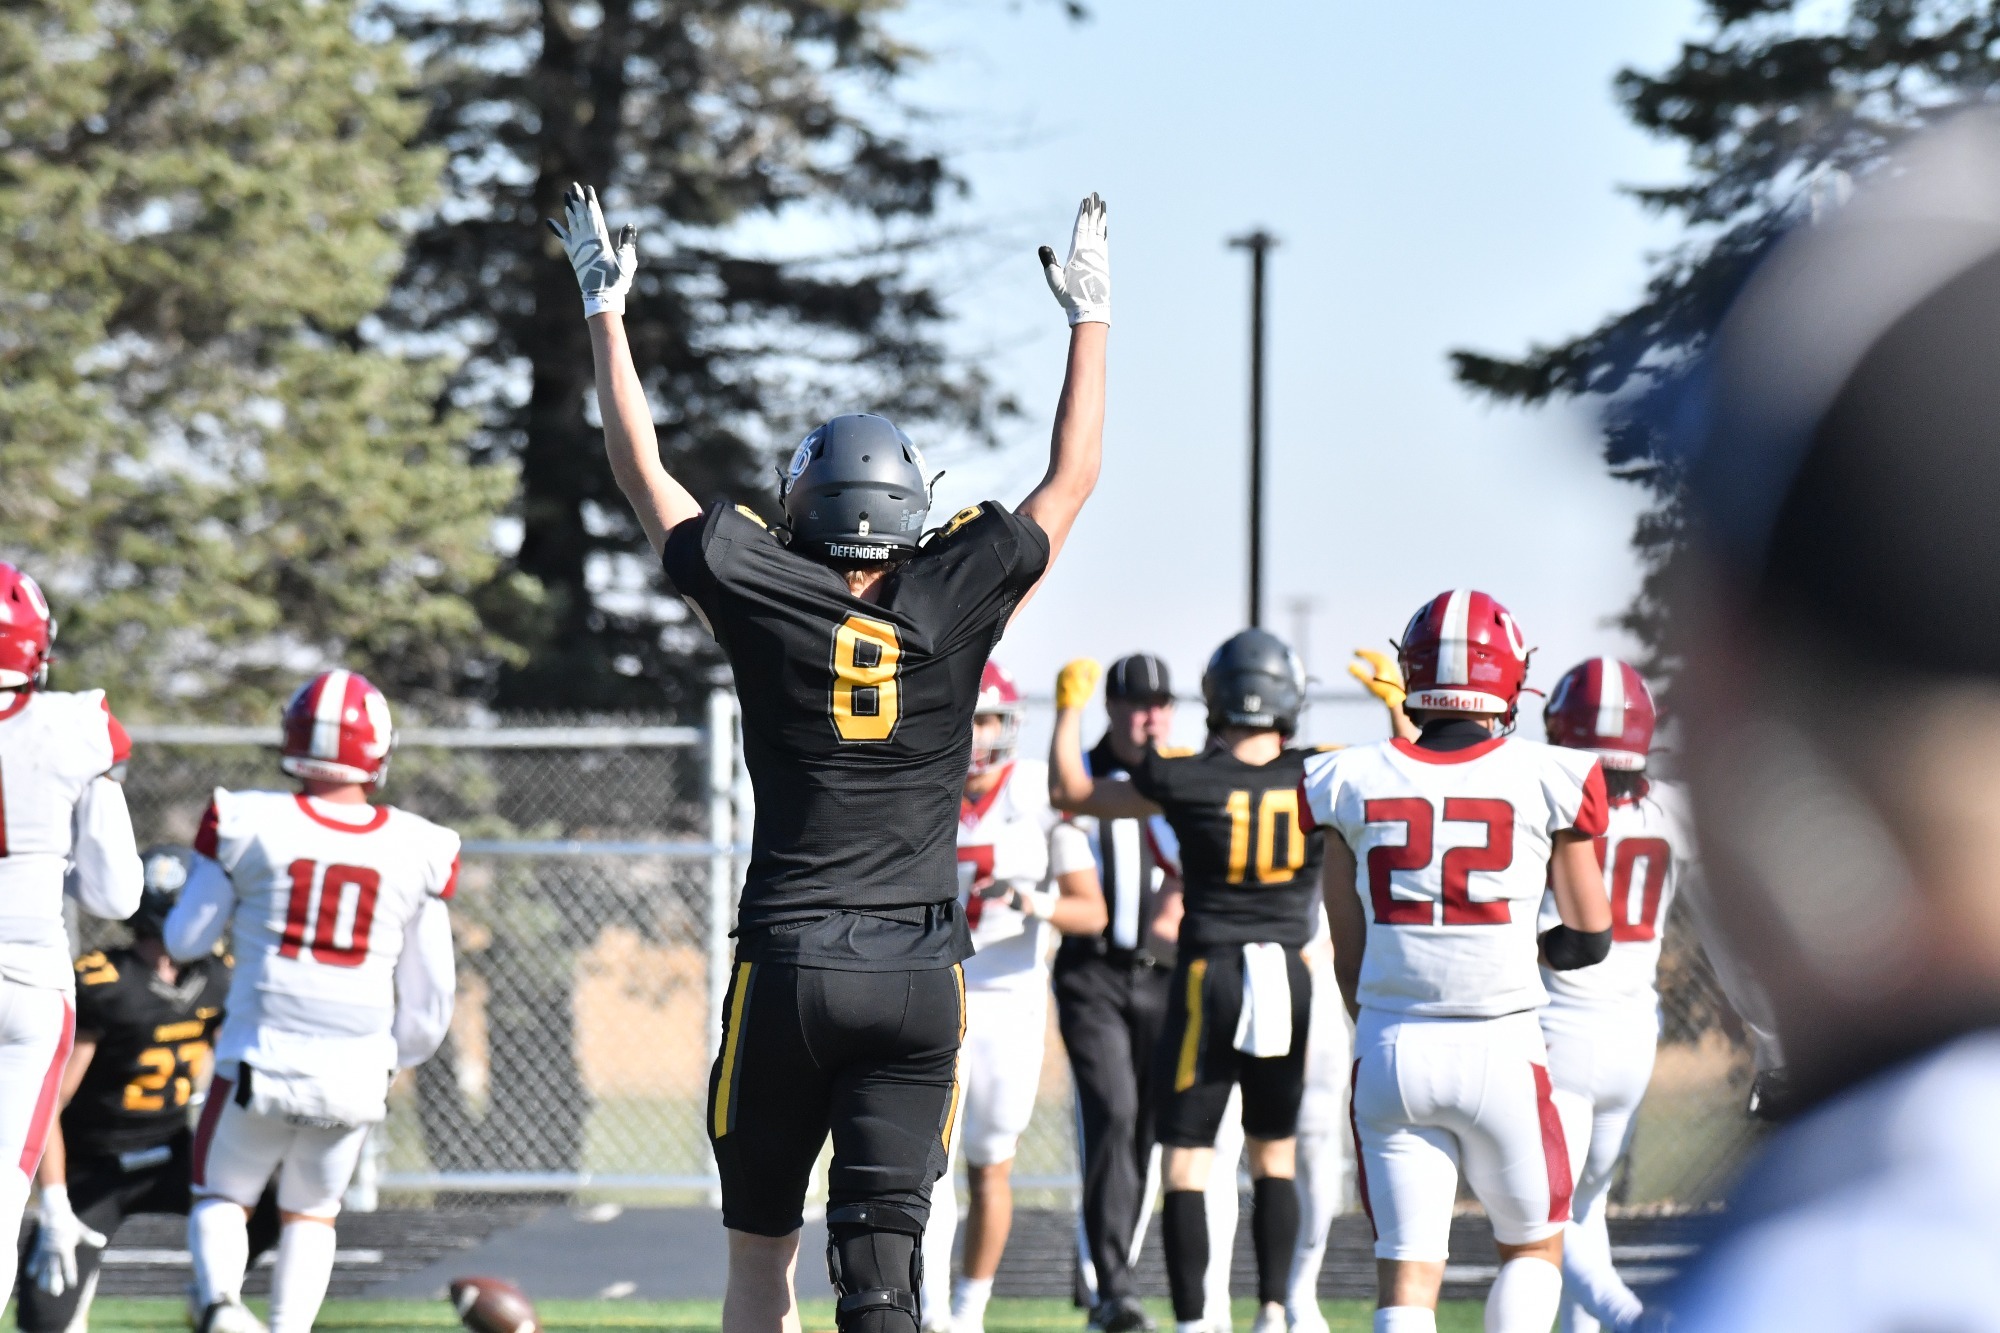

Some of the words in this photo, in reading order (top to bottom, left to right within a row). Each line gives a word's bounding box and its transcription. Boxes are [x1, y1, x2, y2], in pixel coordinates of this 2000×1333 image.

[830, 544, 890, 560] DEFENDERS
[858, 520, 870, 537] 8
[827, 610, 904, 744] 8
[1421, 694, 1484, 710] Riddell
[1223, 789, 1306, 885] 10
[1364, 796, 1515, 926] 22
[277, 858, 381, 968] 10
